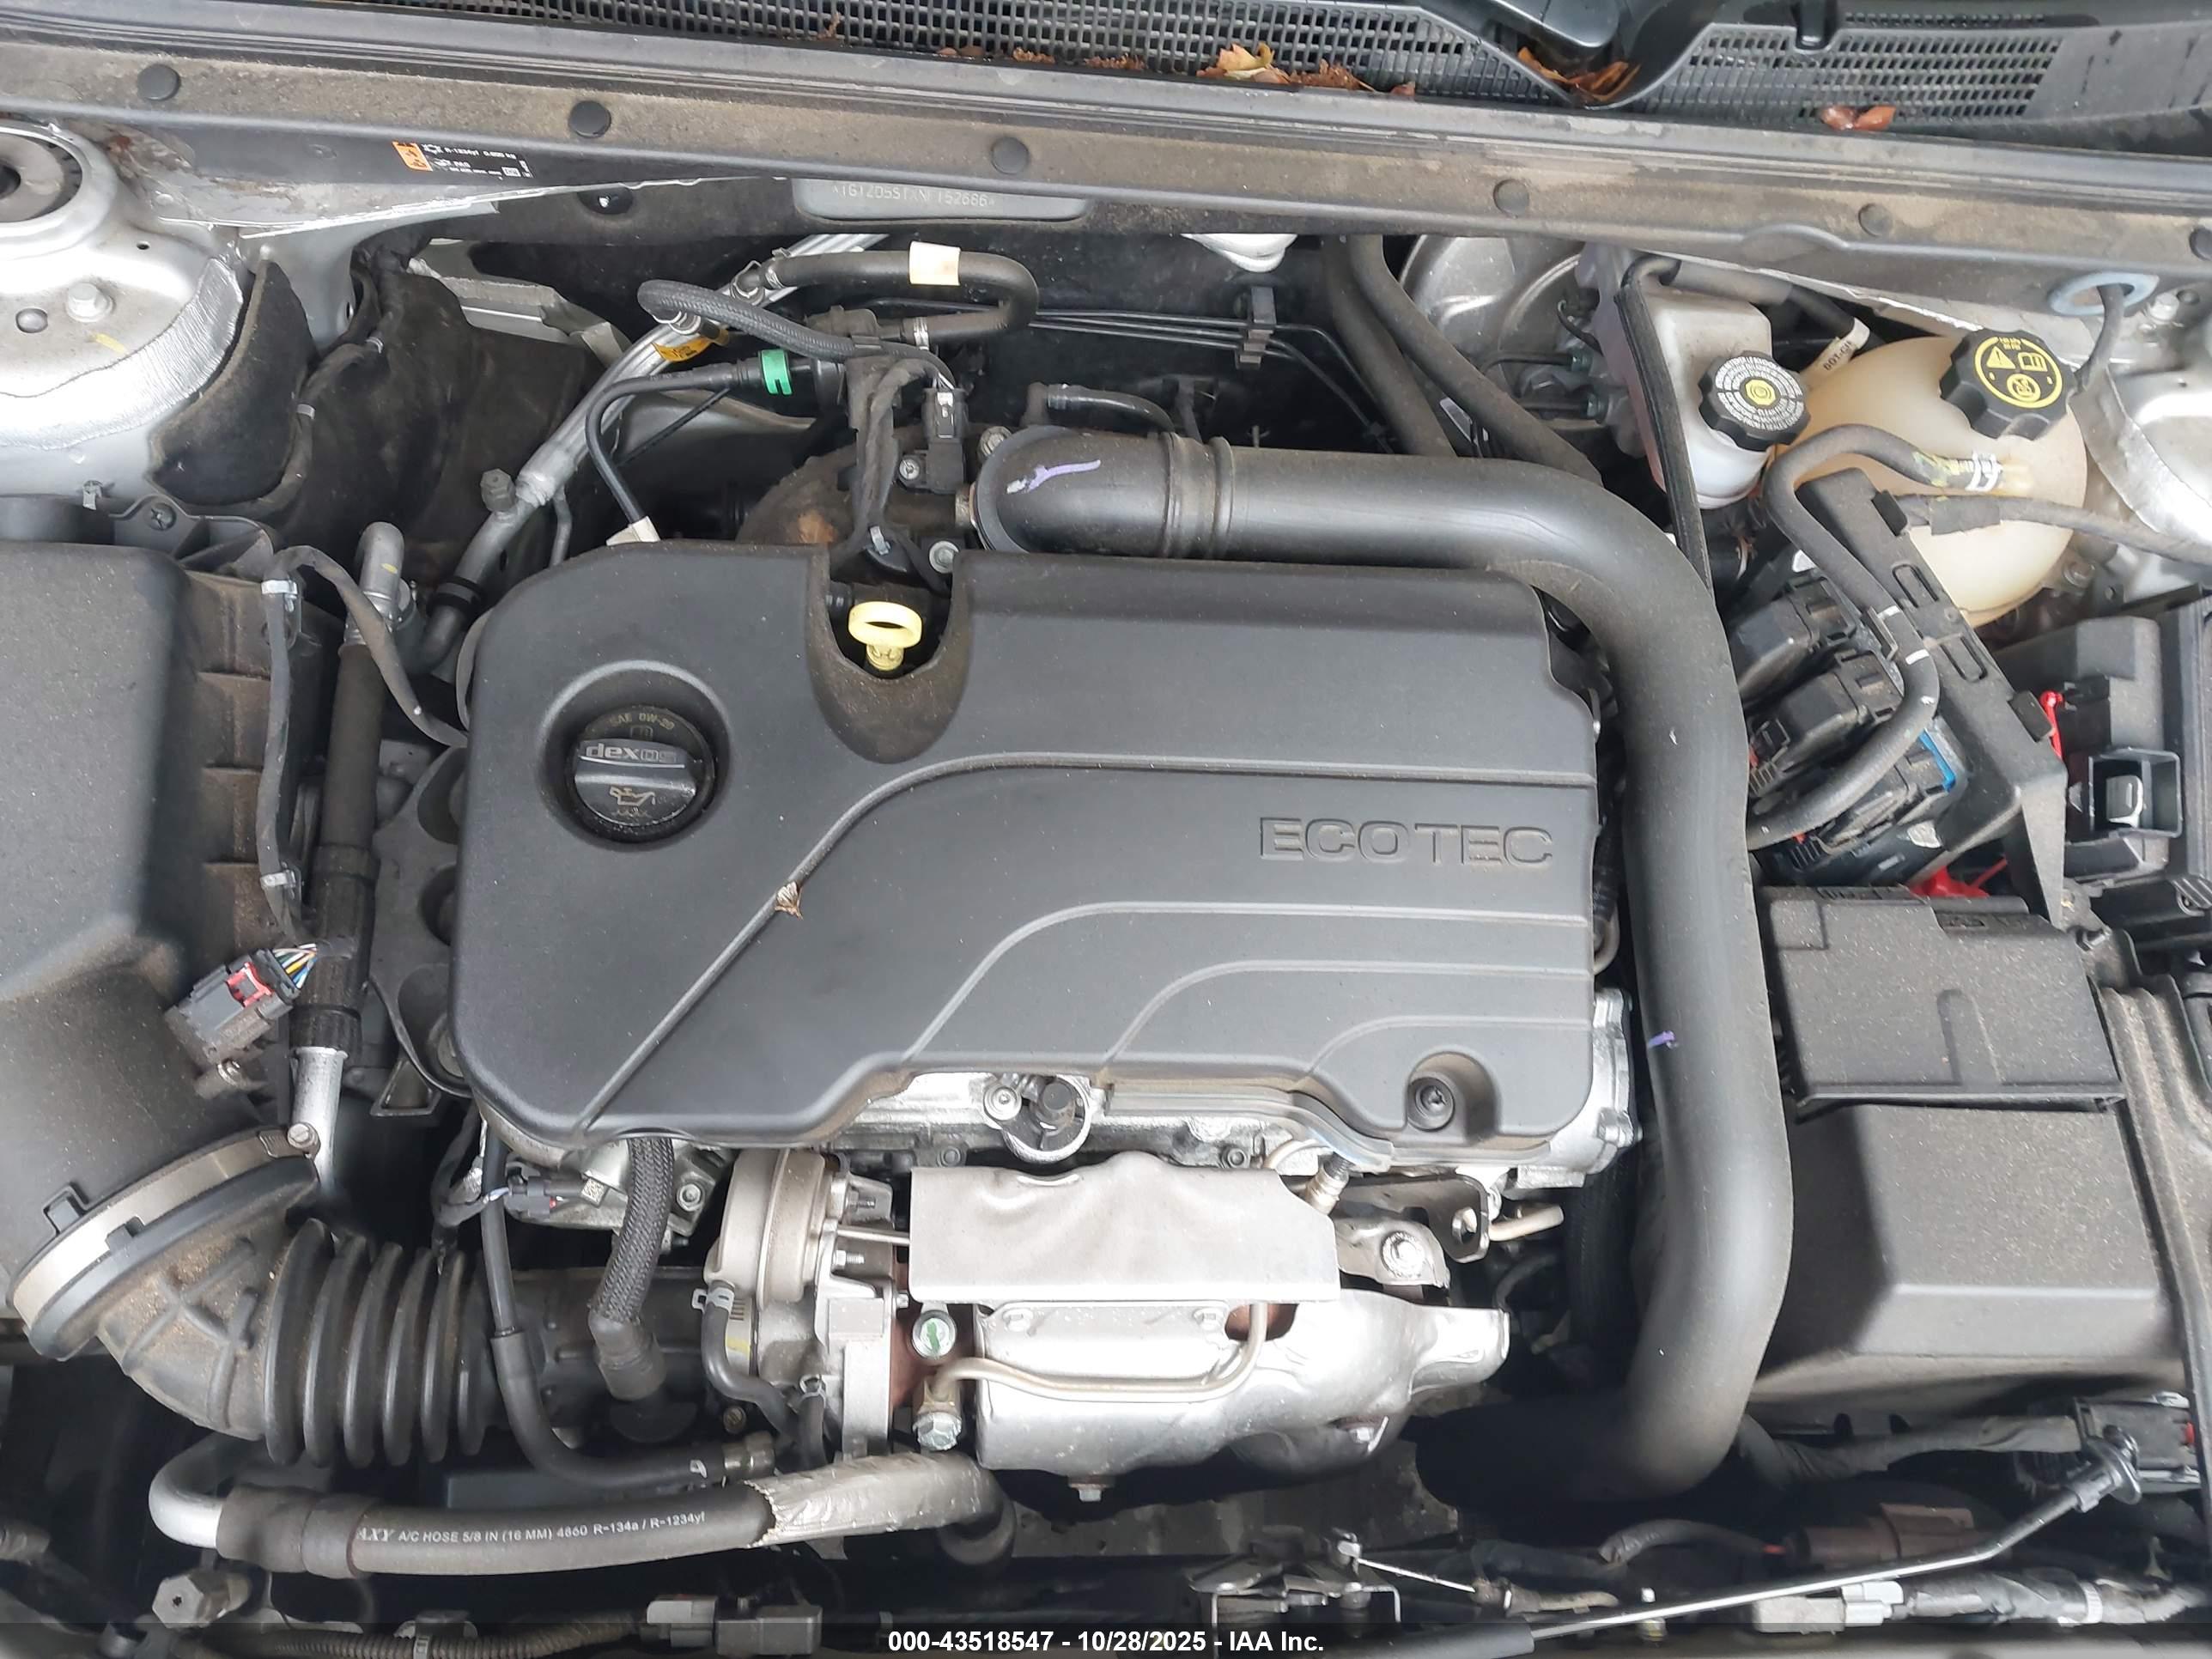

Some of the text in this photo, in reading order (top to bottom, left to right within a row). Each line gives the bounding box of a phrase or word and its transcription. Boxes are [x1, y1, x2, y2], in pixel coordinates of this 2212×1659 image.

[1260, 817, 1553, 866] ECOTEC
[398, 1530, 420, 1542] A/C
[422, 1531, 459, 1543] HOSE
[462, 1531, 482, 1543] 5/8
[485, 1530, 498, 1541] IN
[502, 1529, 521, 1542] (16
[525, 1528, 553, 1540] MM)
[556, 1525, 588, 1538] 4860
